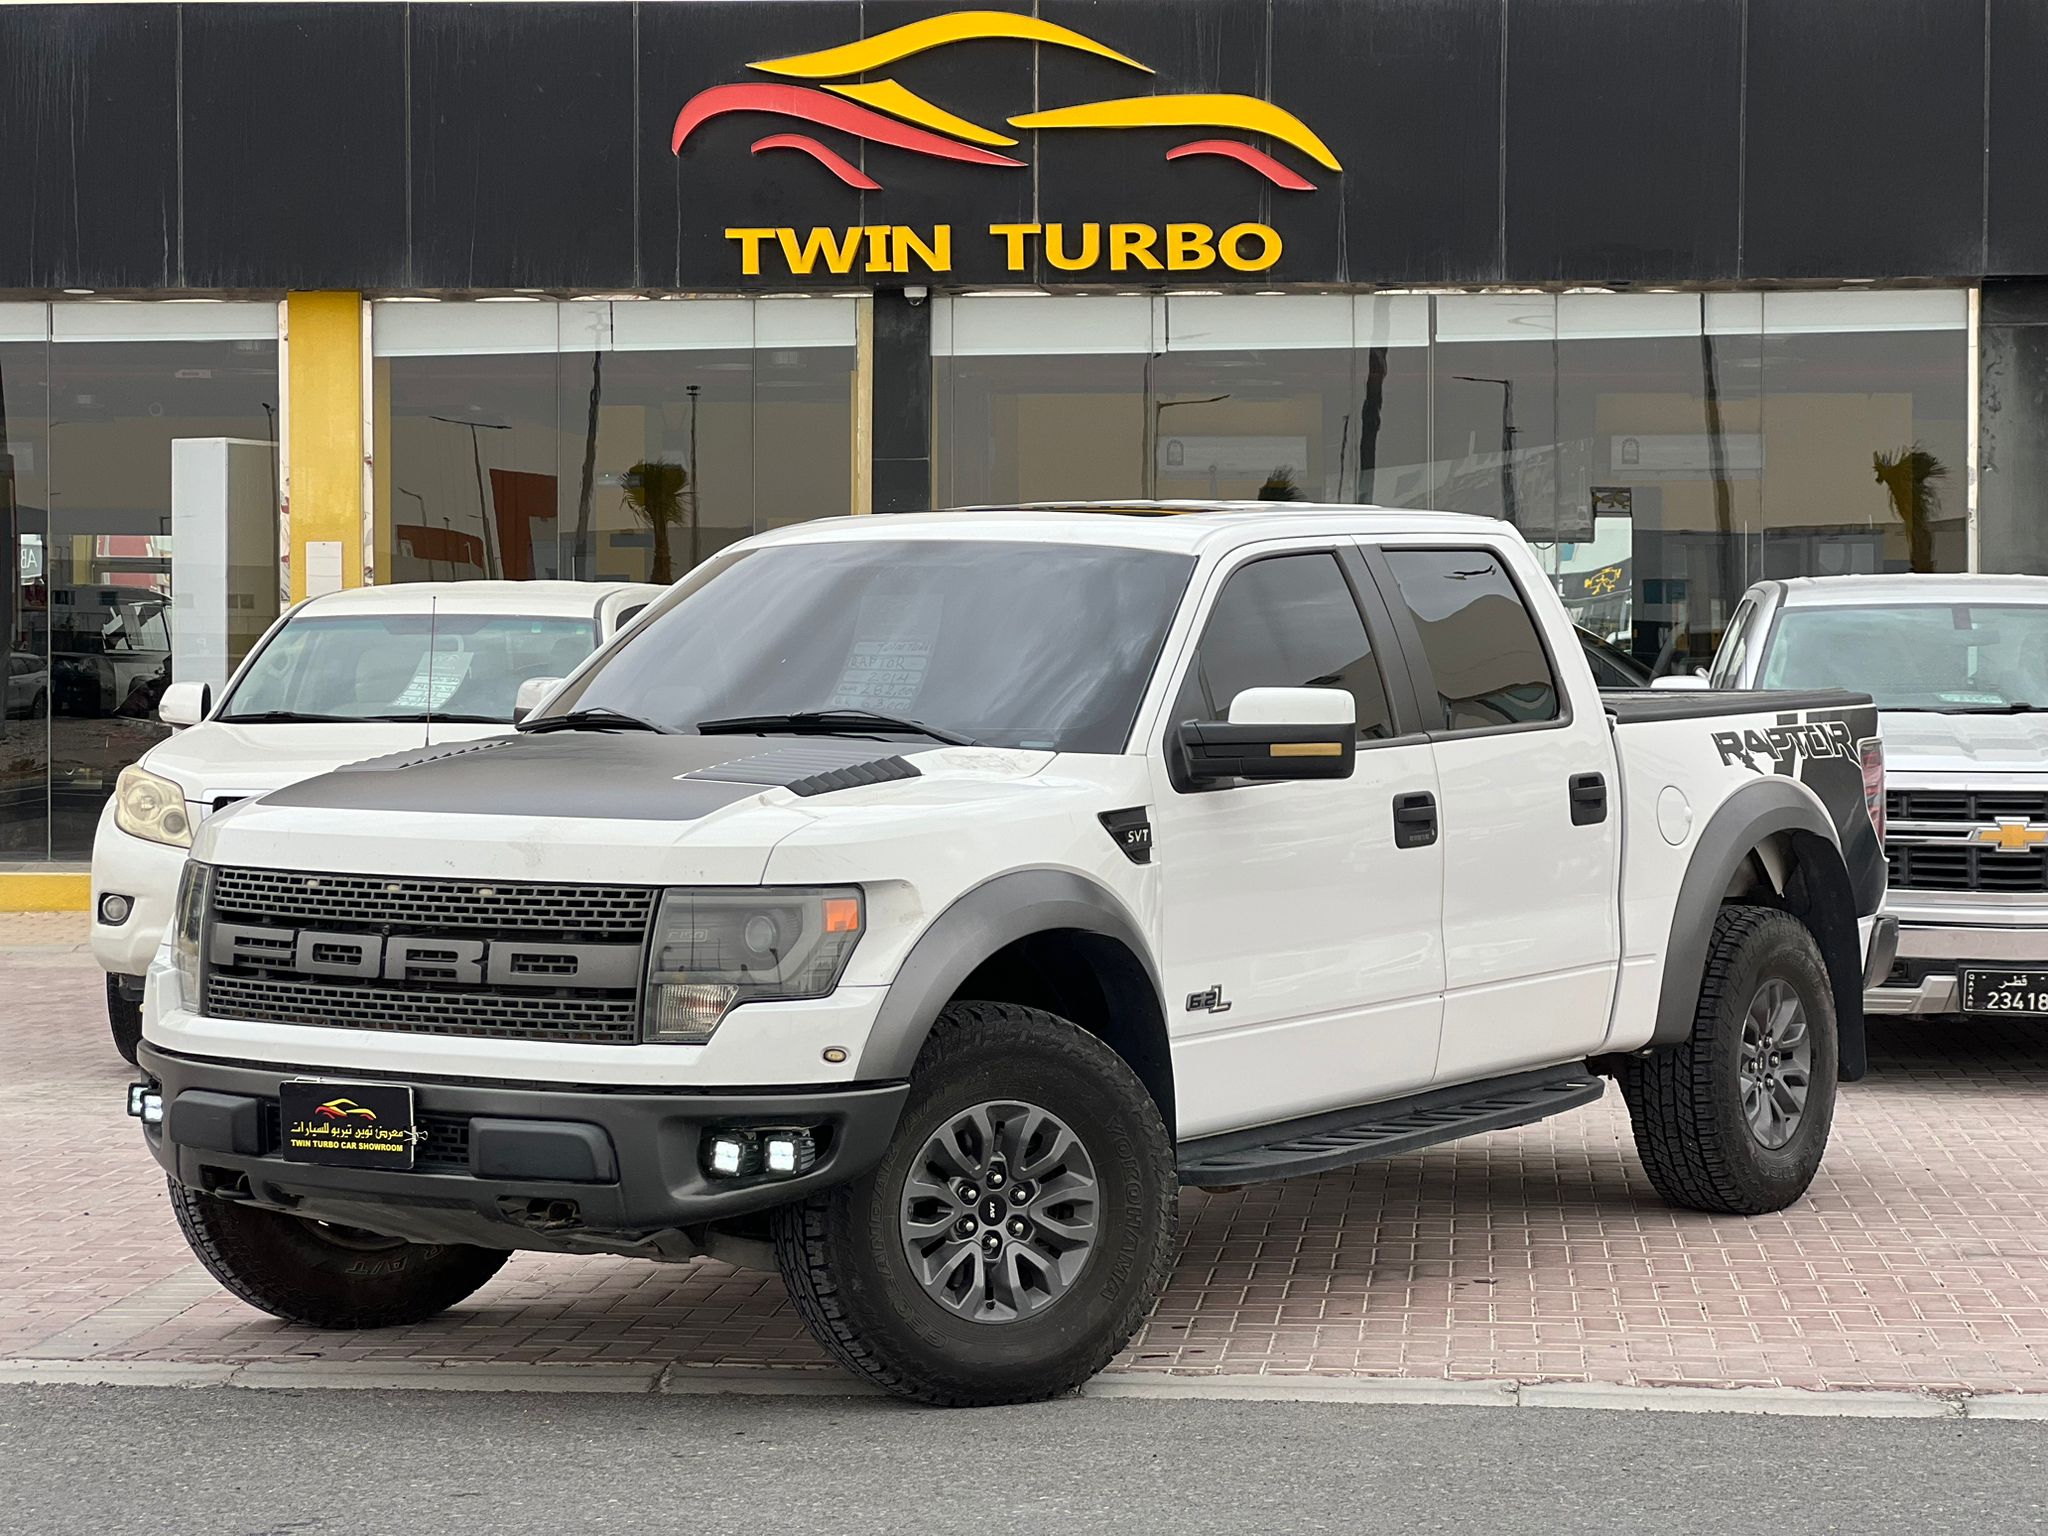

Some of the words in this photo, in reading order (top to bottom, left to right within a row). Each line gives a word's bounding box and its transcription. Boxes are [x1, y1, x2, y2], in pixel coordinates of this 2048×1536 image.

[724, 224, 951, 275] TWIN
[989, 222, 1283, 272] TURBO
[1711, 720, 1861, 768] RAPTOR
[1127, 828, 1149, 844] SVT
[209, 921, 644, 989] FORD
[1997, 974, 2028, 989] قطر
[1967, 973, 1976, 1008] QATAR
[1986, 991, 2048, 1011] 23418
[290, 1121, 330, 1137] للسيارات
[330, 1123, 353, 1138] تيربو
[354, 1124, 374, 1139] توين
[375, 1125, 404, 1140] معرض
[290, 1139, 311, 1148] TWIN
[312, 1140, 339, 1149] TURBO
[341, 1141, 357, 1150] CAR
[358, 1142, 403, 1152] SHOWROOM
[1099, 1115, 1143, 1302] YOKOHAMA
